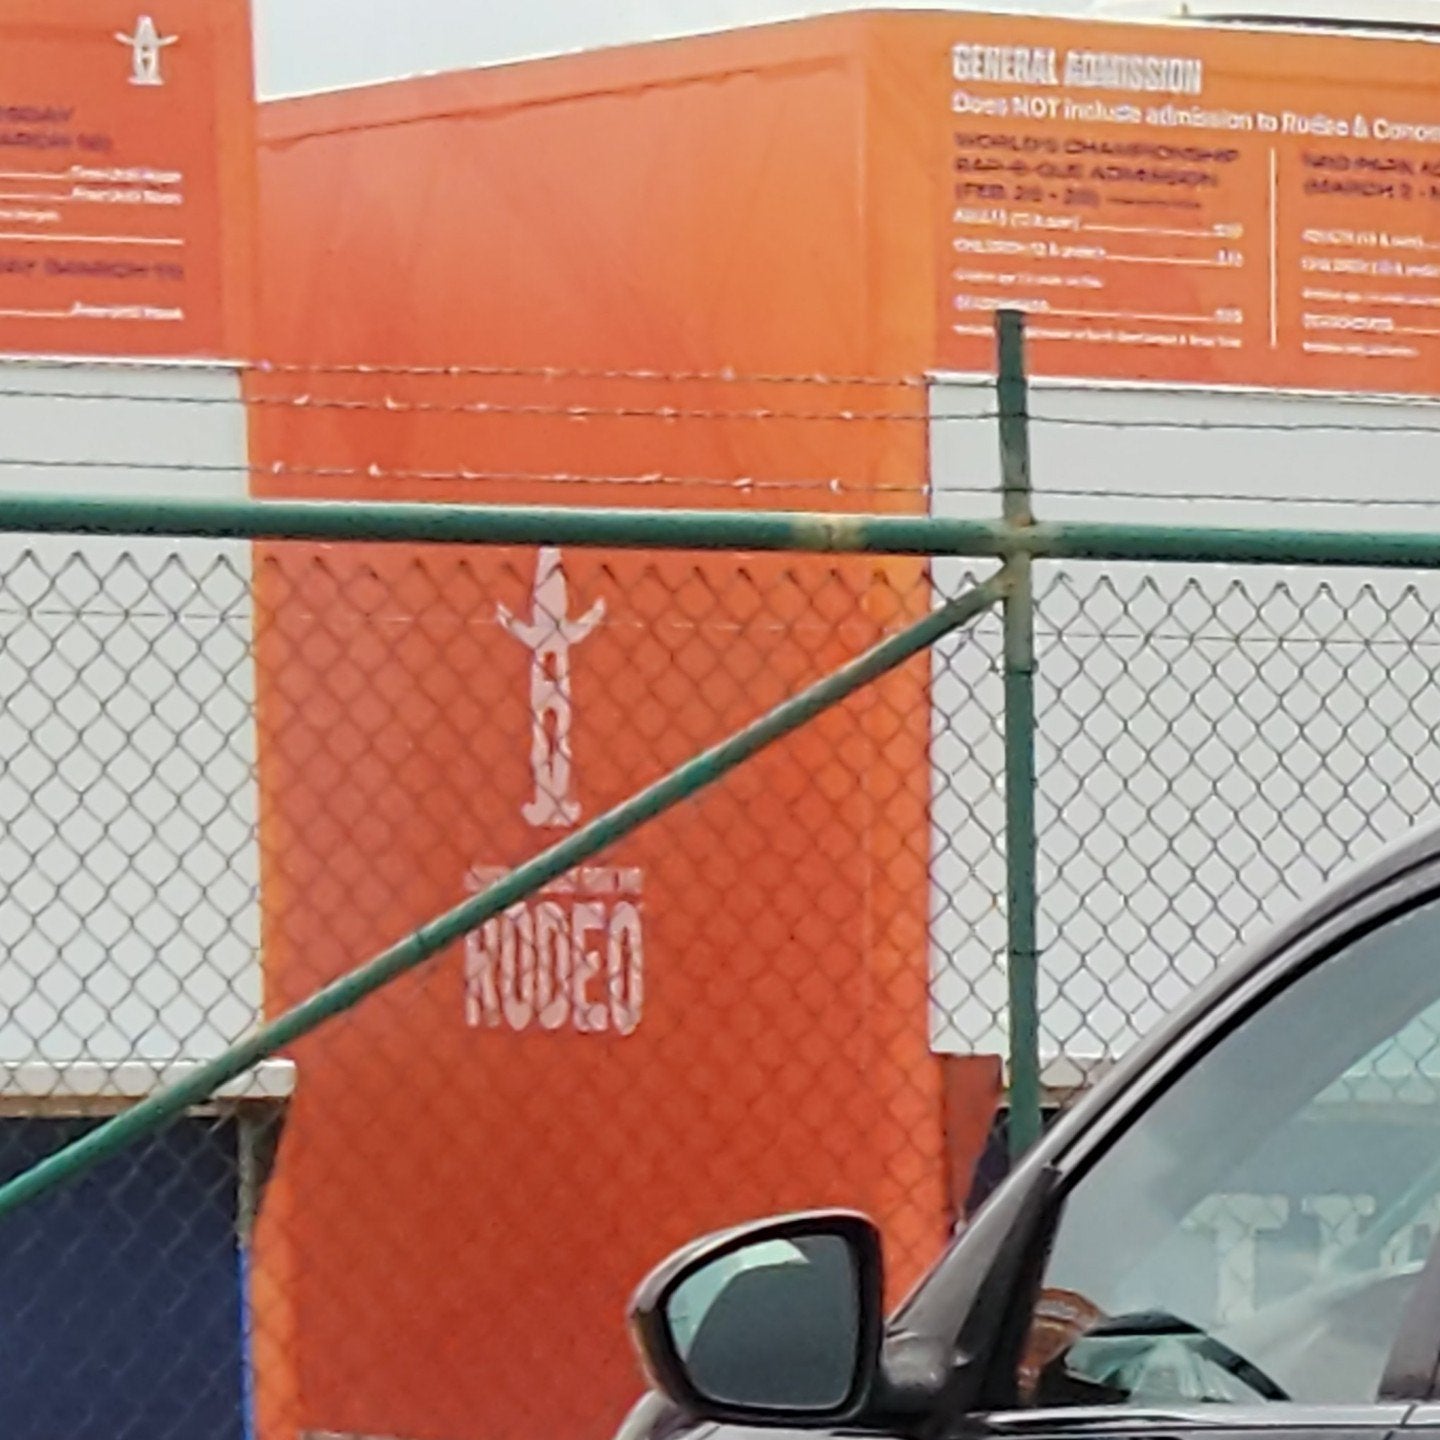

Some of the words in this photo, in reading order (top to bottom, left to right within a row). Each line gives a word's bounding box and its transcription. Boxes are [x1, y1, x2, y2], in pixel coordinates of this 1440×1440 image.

[953, 43, 1058, 85] GENERAL
[1063, 50, 1202, 94] ADMISSION
[952, 91, 1007, 116] Does
[1013, 95, 1059, 116] NOT
[1064, 100, 1142, 124] include
[1146, 104, 1253, 130] admission
[464, 901, 644, 1036] RODEO
